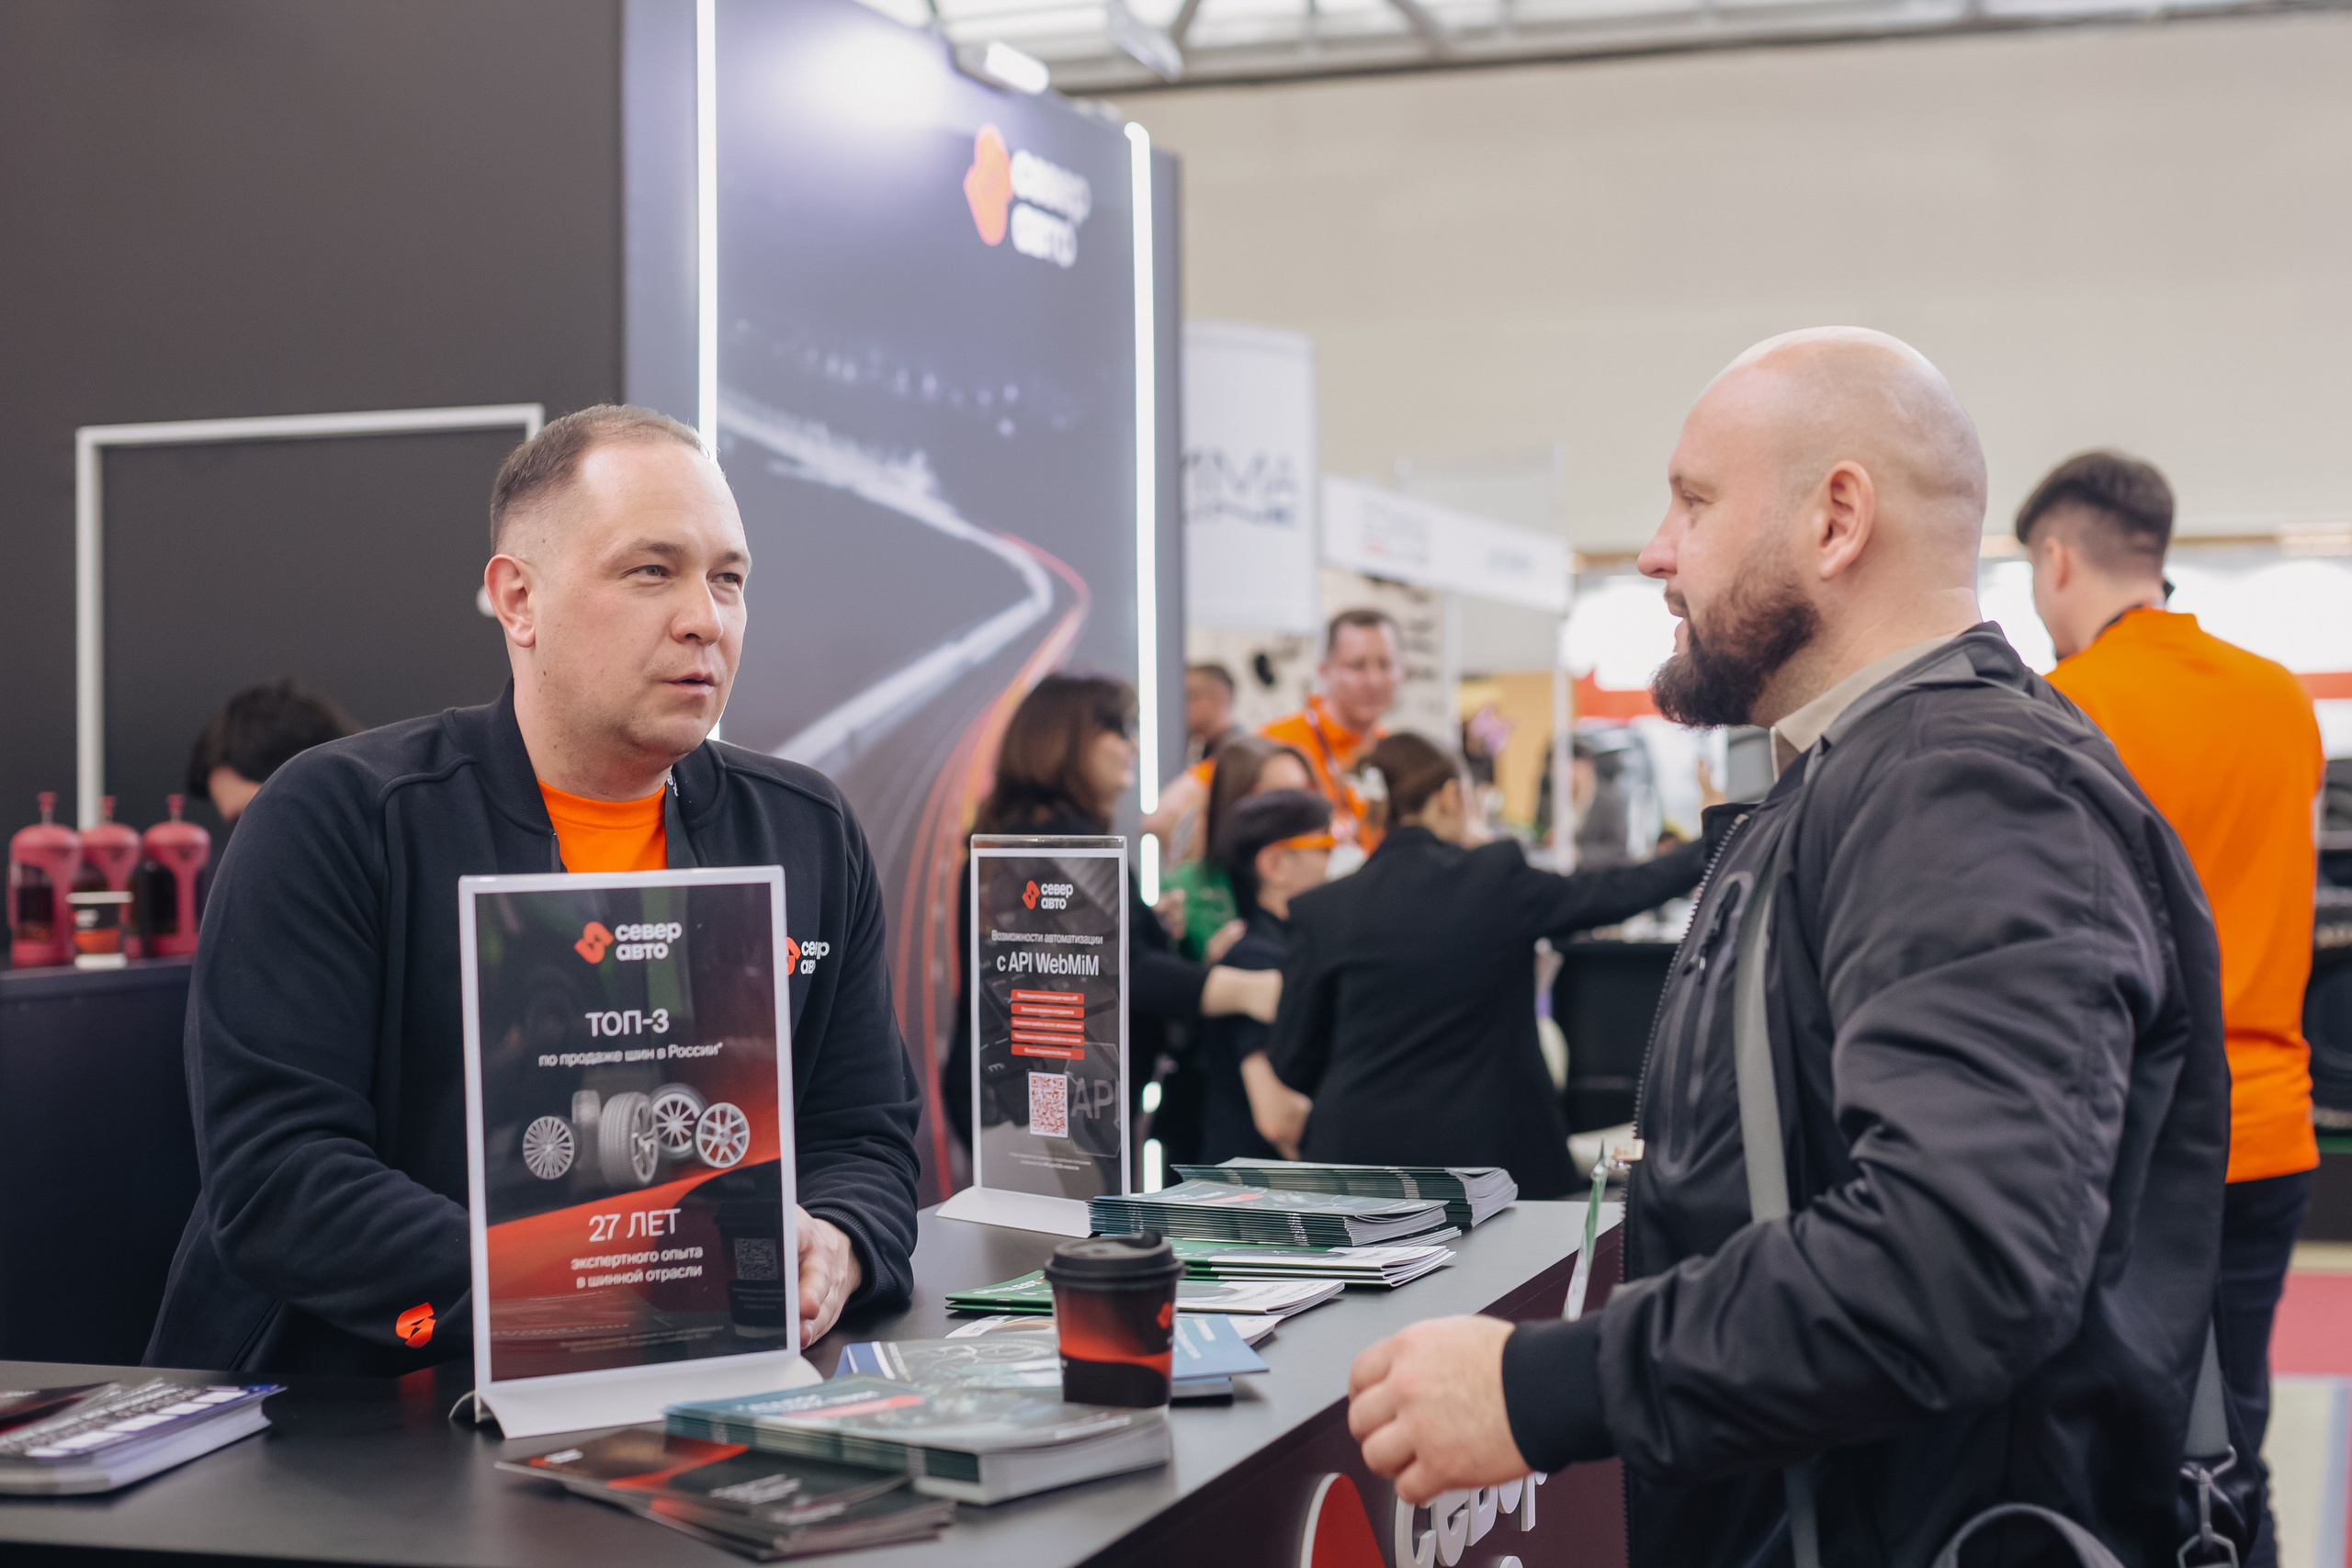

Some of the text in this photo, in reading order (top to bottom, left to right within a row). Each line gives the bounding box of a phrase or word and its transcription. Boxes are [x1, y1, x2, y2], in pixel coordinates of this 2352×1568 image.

[1040, 883, 1074, 898] север
[1040, 897, 1067, 909] авто
[615, 922, 683, 943] север
[991, 930, 1043, 942] Возможности
[616, 942, 669, 962] авто
[1008, 951, 1032, 973] API
[1035, 953, 1099, 976] WebMiM
[585, 1009, 670, 1037] ТОП-3
[538, 1054, 558, 1066] по
[560, 1050, 623, 1067] продаже
[625, 1048, 655, 1062] шин
[657, 1047, 666, 1059] в
[589, 1208, 682, 1243] 27 ЛЕТ
[571, 1247, 704, 1270] экспертного опыта
[576, 1265, 703, 1289] в шинной отрасли
